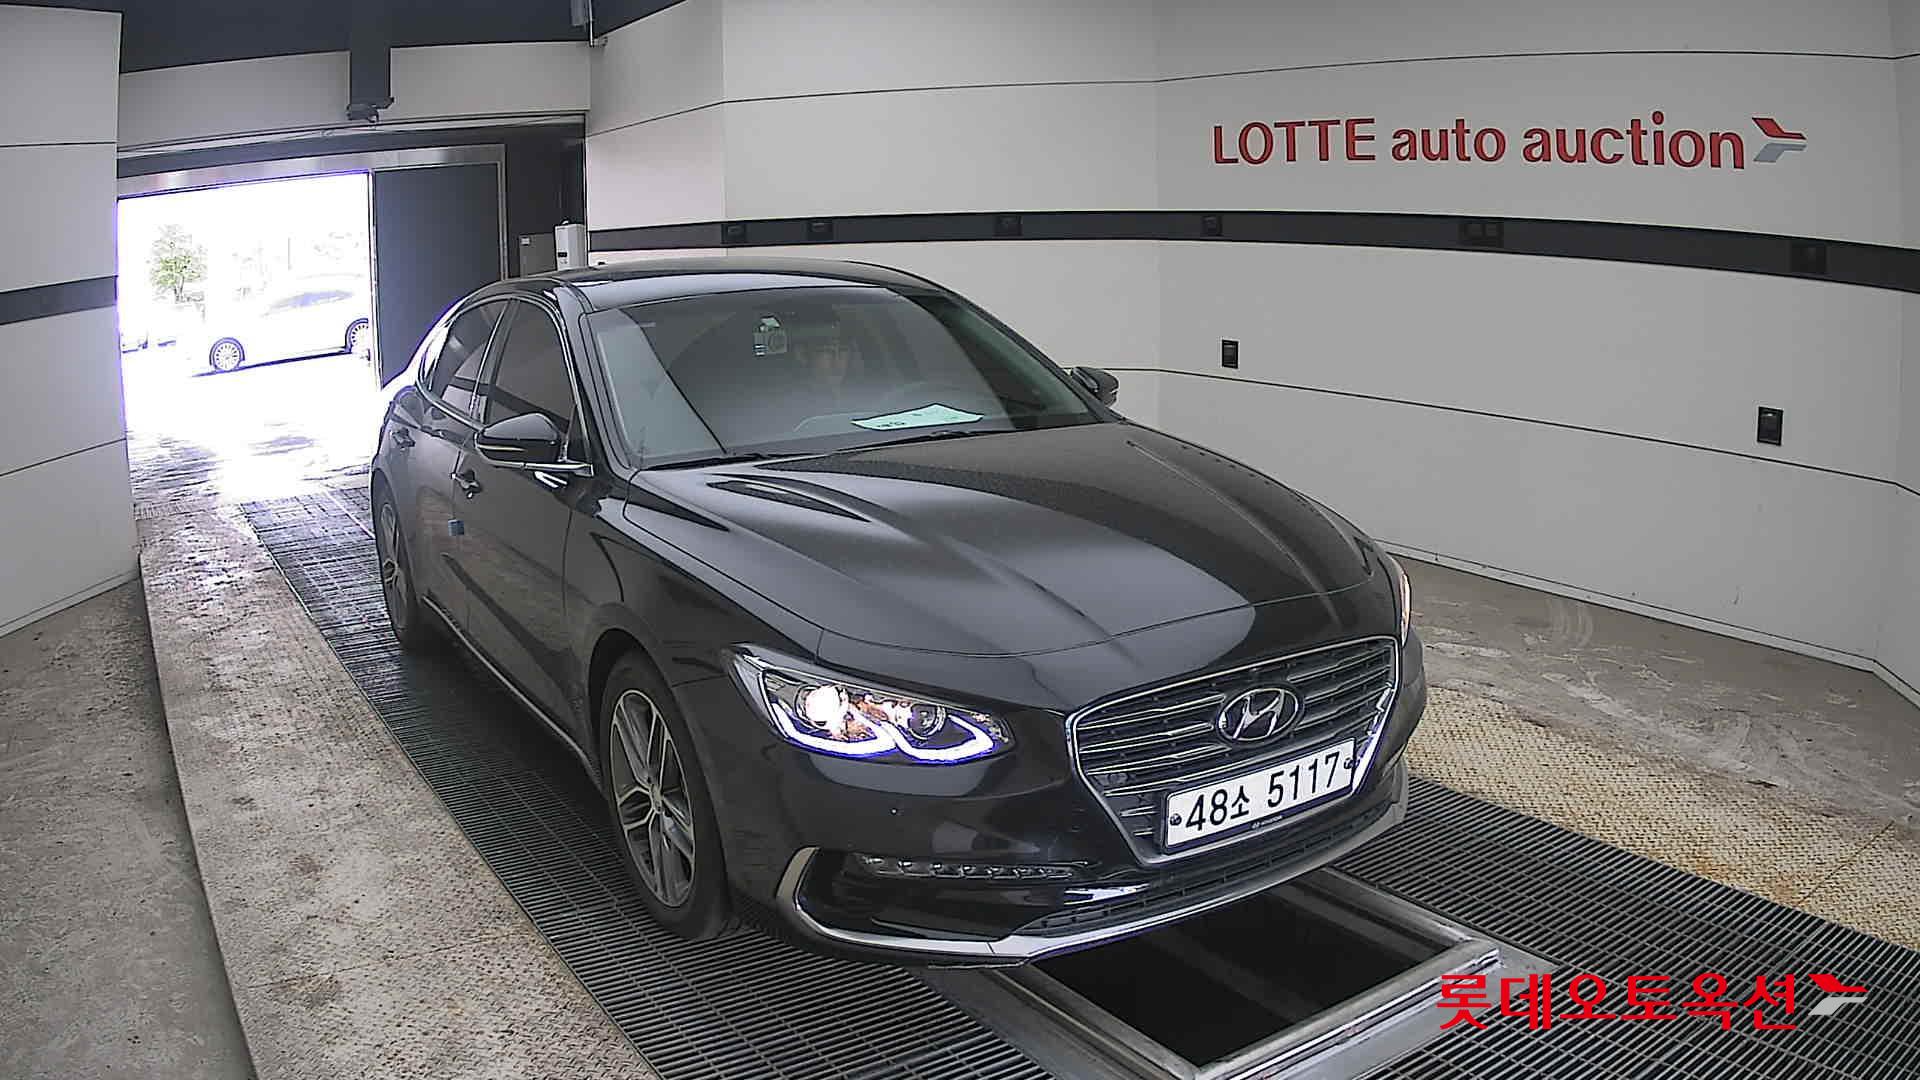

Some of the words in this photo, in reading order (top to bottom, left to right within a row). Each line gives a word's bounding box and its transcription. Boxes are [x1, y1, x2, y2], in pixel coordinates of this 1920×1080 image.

[1213, 117, 1376, 165] LOTTE
[1391, 118, 1507, 162] auto
[1522, 110, 1745, 170] auction
[1185, 784, 1251, 832] 48소
[1266, 750, 1341, 809] 5117
